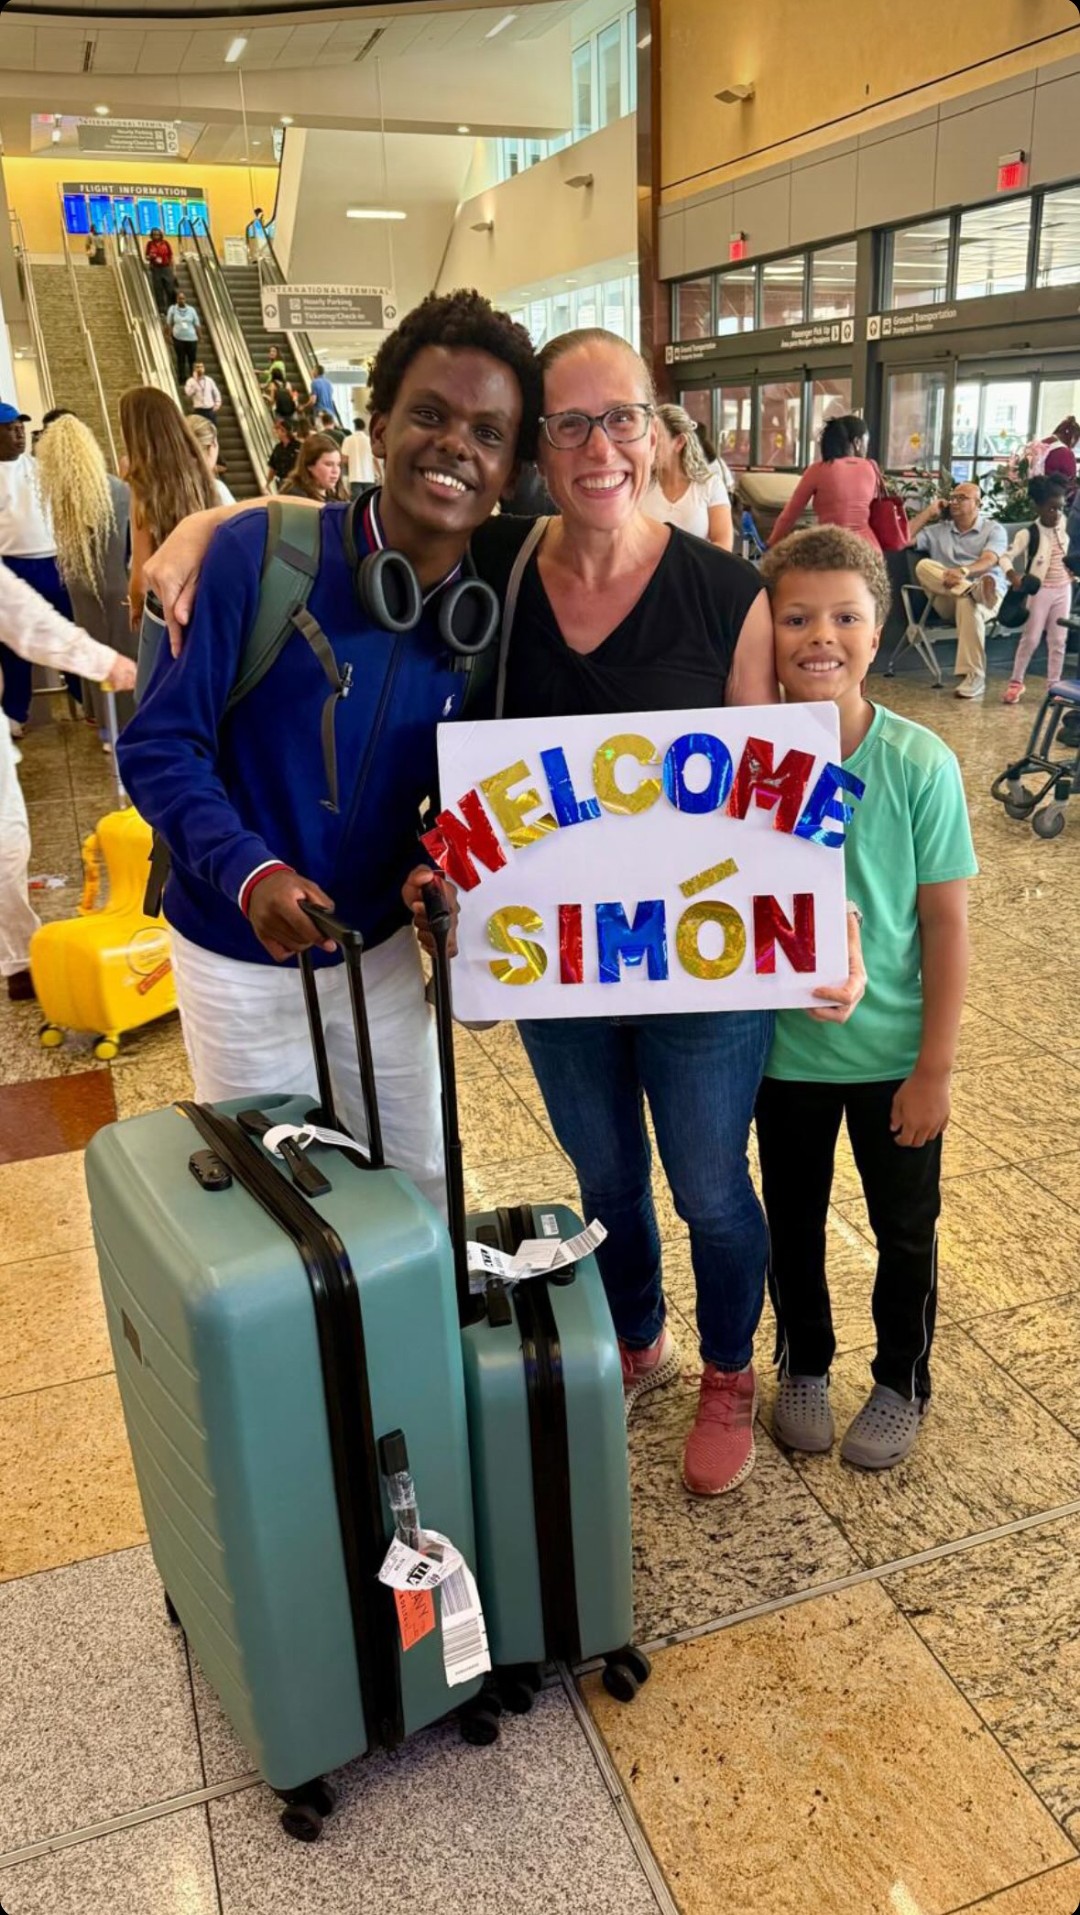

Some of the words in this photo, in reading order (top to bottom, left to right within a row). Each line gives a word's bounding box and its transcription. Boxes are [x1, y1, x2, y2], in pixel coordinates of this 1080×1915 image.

[80, 184, 114, 193] FLIGHT
[119, 186, 188, 196] INFORMATION
[265, 286, 340, 294] INTERNATIONAL
[344, 286, 389, 295] TERMINAL
[892, 313, 914, 325] Ground
[915, 308, 957, 322] Transportation
[420, 732, 866, 892] WELCOME
[486, 857, 817, 986] SIMÓN
[406, 1561, 432, 1587] ATL
